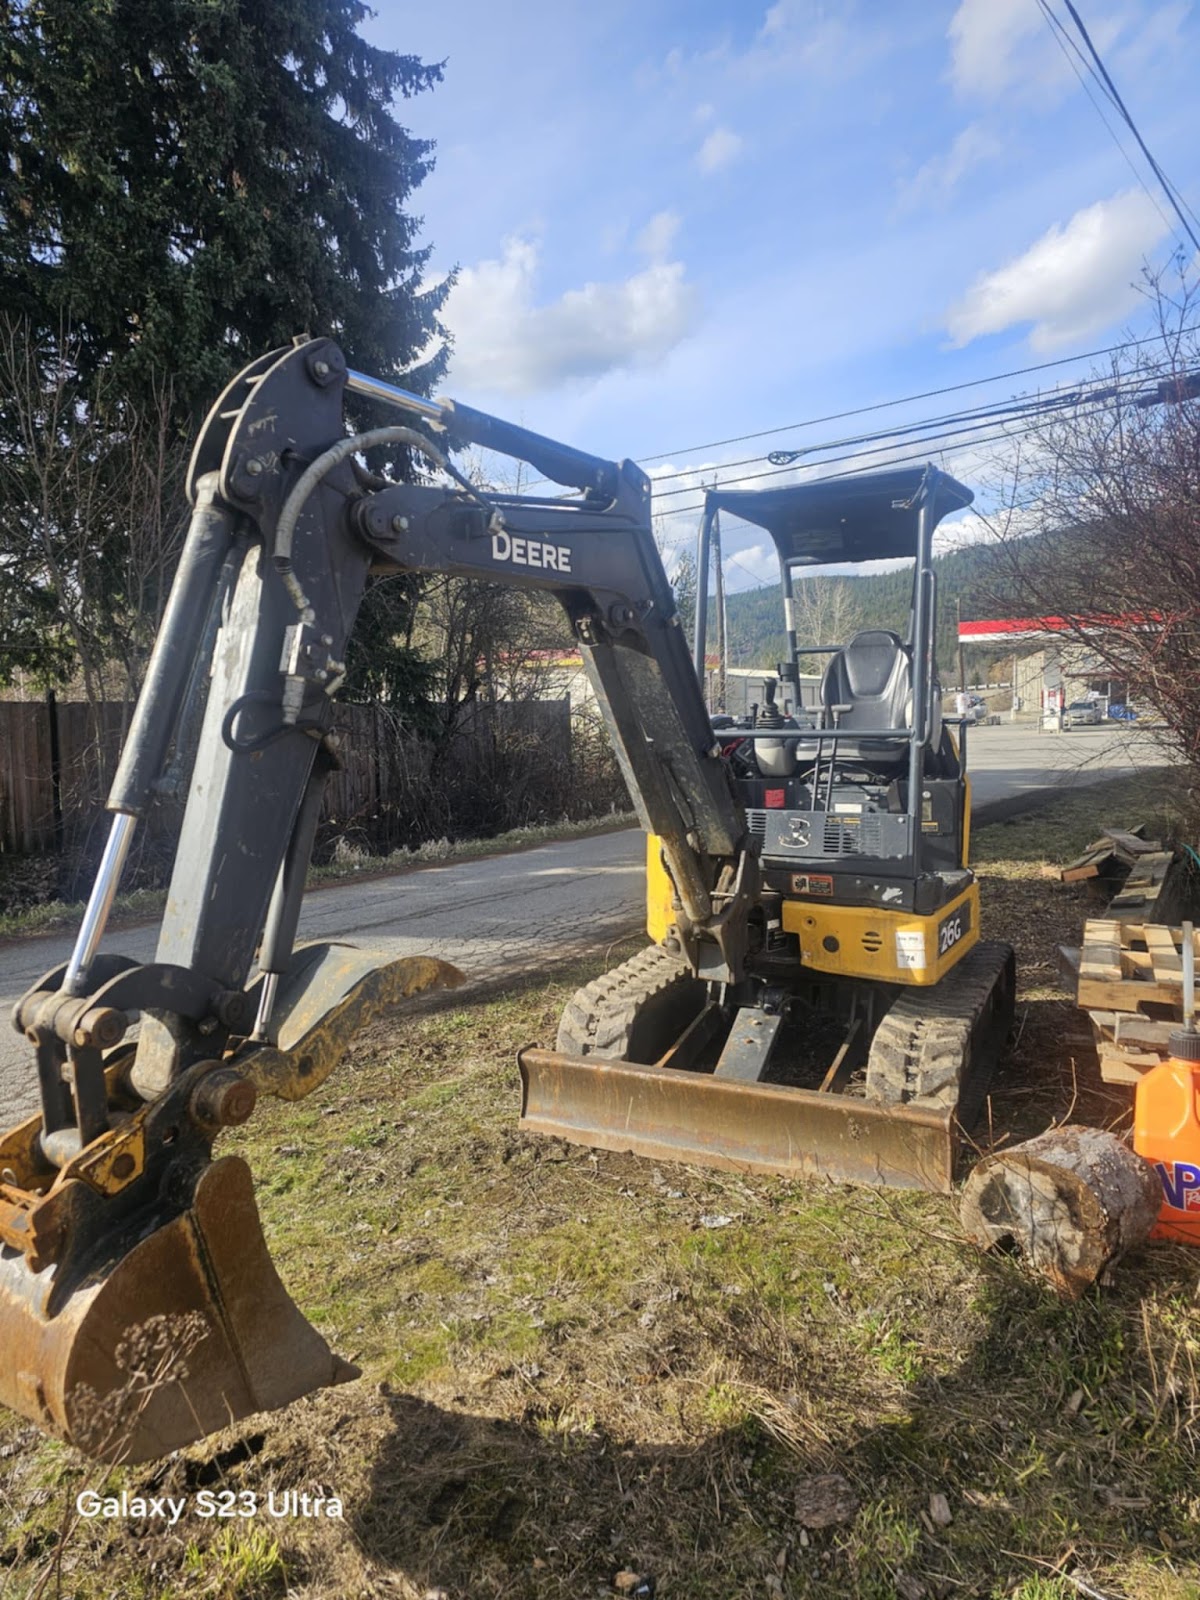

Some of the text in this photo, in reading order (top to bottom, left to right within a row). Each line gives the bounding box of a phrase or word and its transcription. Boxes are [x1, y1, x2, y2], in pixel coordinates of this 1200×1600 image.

[492, 529, 571, 572] DEERE
[941, 918, 961, 954] 26G
[1153, 1161, 1200, 1211] VP
